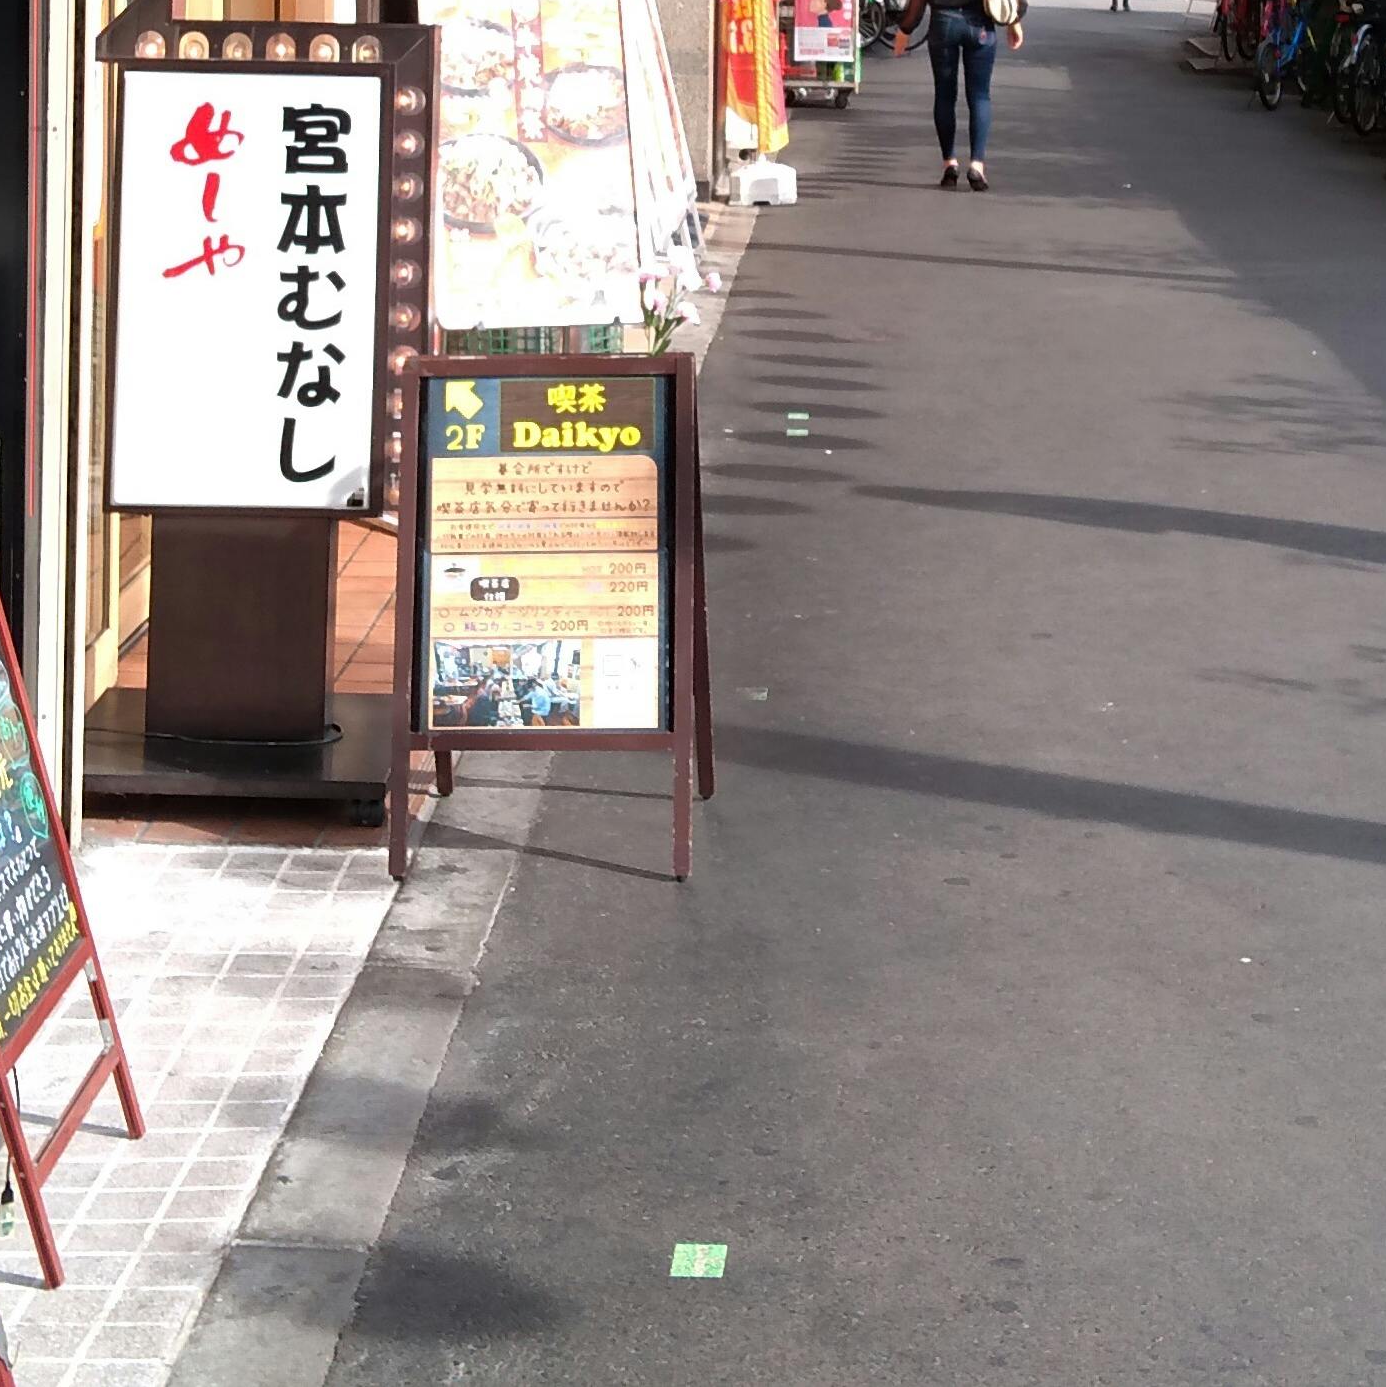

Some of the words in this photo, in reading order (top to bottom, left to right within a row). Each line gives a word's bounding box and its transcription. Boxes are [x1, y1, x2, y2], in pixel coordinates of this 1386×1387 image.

[161, 101, 246, 279] めしや
[276, 102, 352, 484] 宮本むなし
[547, 383, 608, 414] 喫茶
[446, 424, 486, 450] 2F
[513, 420, 642, 452] Daikyo
[609, 562, 647, 575] 200円
[609, 581, 650, 594] 220円
[617, 605, 655, 618] 200円
[550, 619, 589, 632] 200円
